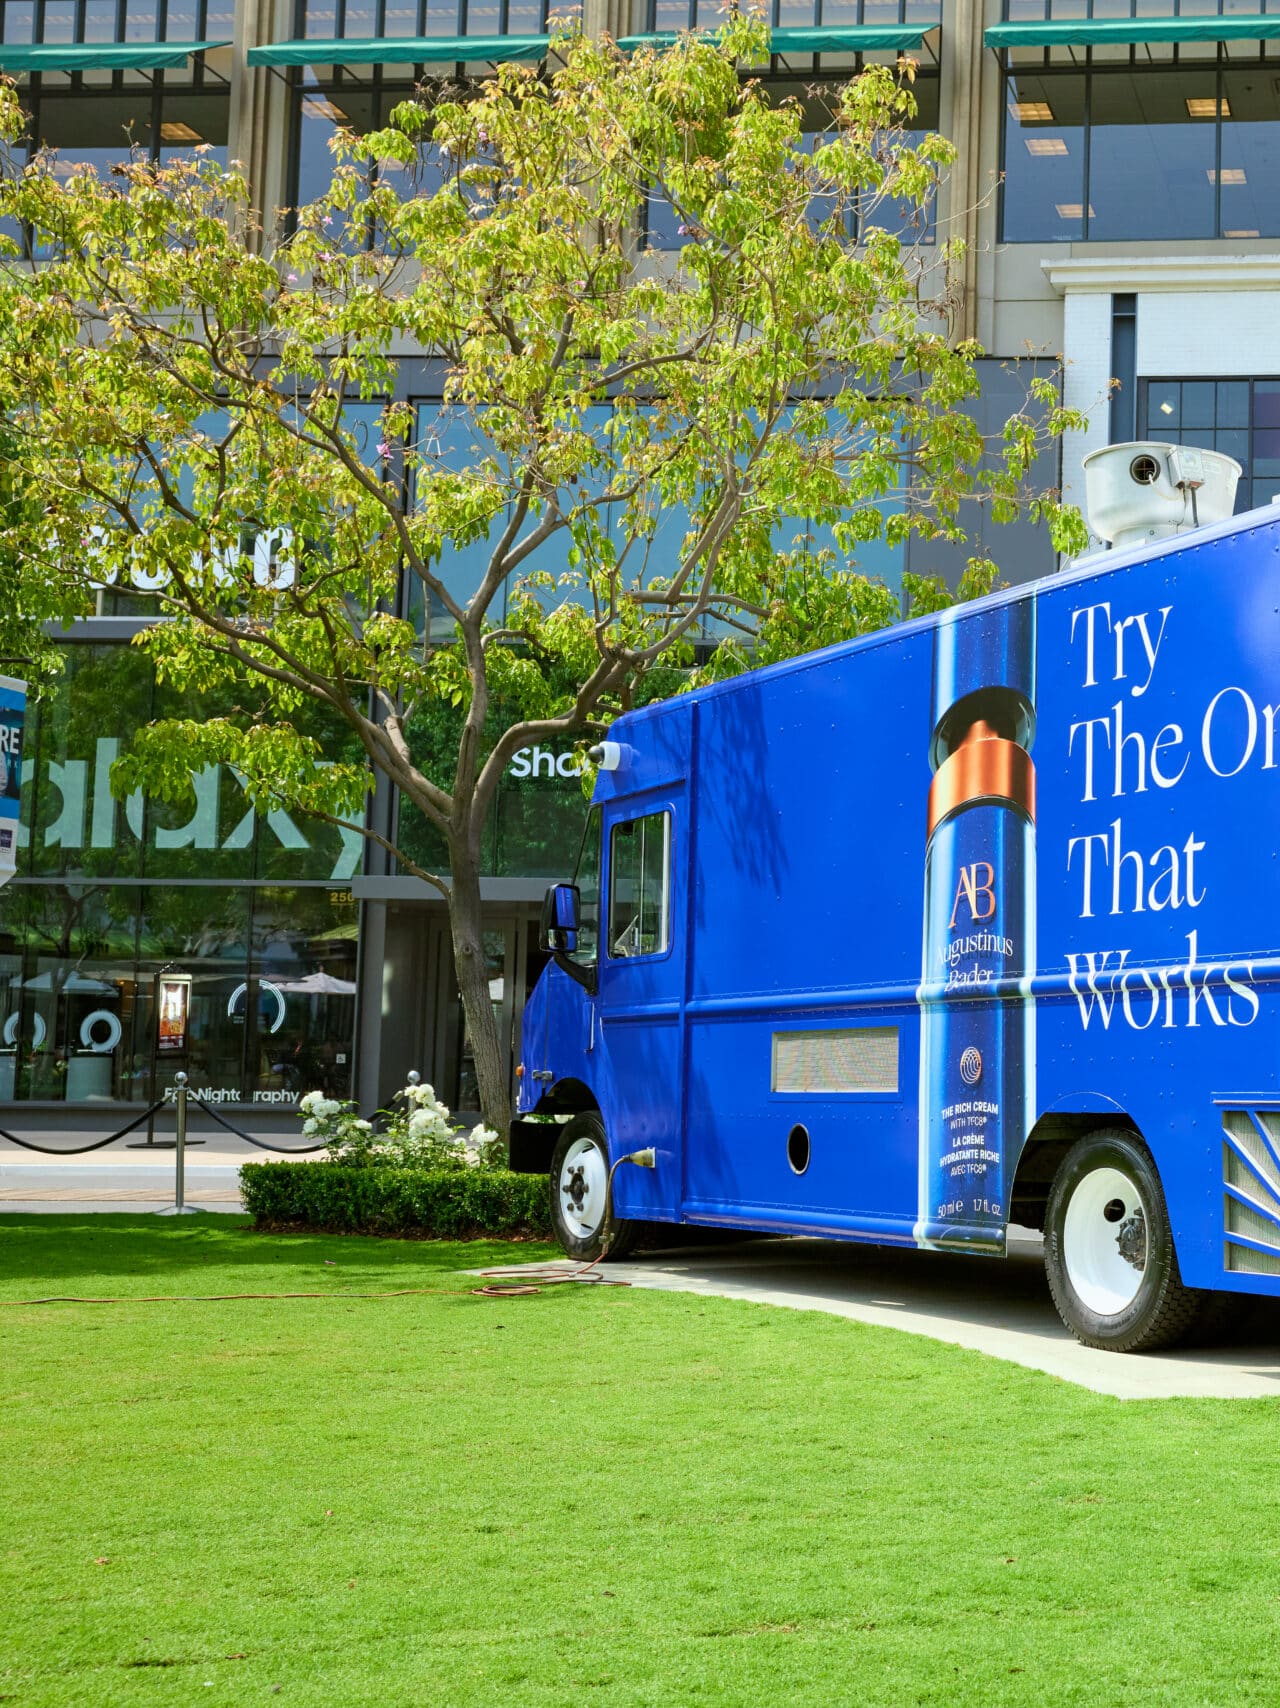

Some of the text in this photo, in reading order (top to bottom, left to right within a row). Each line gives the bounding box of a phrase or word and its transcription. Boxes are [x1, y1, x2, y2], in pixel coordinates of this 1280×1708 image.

[1070, 601, 1173, 697] Try
[510, 746, 593, 777] Sha
[1068, 700, 1190, 802] The
[1067, 818, 1207, 918] That
[938, 929, 1013, 967] Augustinus
[1064, 929, 1260, 1030] Works
[941, 1101, 999, 1120] THE RICH CREAM
[950, 1117, 966, 1130] WITH
[952, 1136, 961, 1147] LA
[940, 1149, 1000, 1168] HYDRATANTE RICHE
[951, 1164, 966, 1177] AVEC
